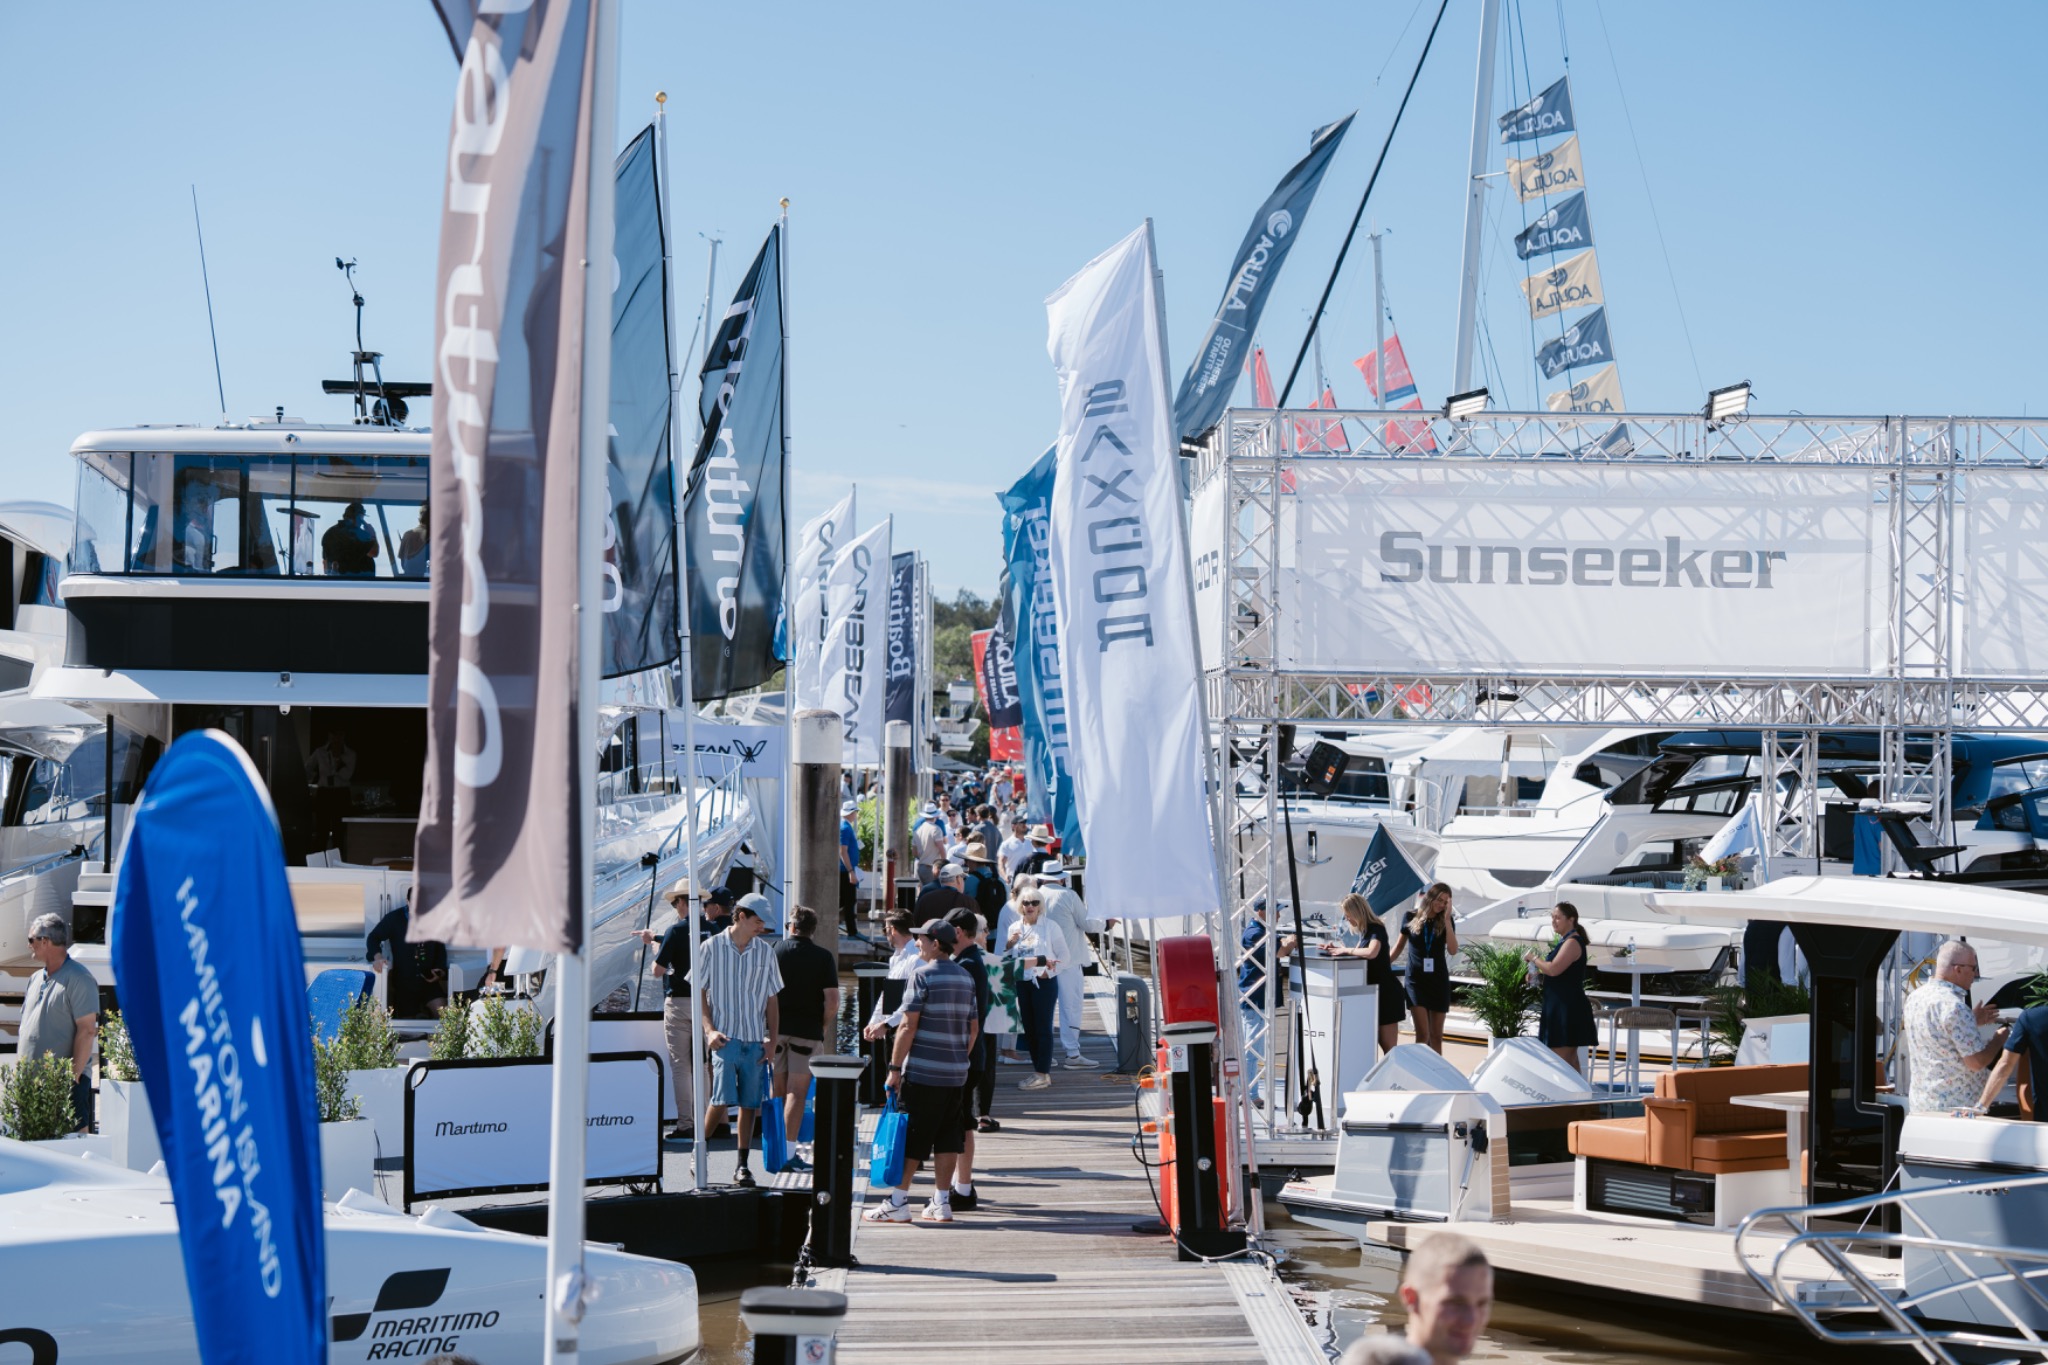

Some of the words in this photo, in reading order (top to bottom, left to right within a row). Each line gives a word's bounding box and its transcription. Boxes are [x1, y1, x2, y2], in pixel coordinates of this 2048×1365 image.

[1226, 234, 1275, 311] AQUILA
[1206, 335, 1224, 371] STARTS
[1220, 338, 1232, 359] OUT
[438, 0, 534, 786] aritimo
[1208, 358, 1226, 387] THERE
[1379, 530, 1787, 589] Sunseeker
[843, 545, 872, 744] CARIBBEAN
[994, 636, 1020, 709] AQUILA
[177, 876, 247, 1123] HAMILTON
[235, 1124, 282, 1298] ISLAND
[179, 998, 242, 1229] MARINA
[435, 1120, 507, 1137] Maritimo
[585, 1114, 635, 1127] ritimo
[366, 1335, 460, 1361] RACING
[372, 1311, 500, 1339] MARITIMO
